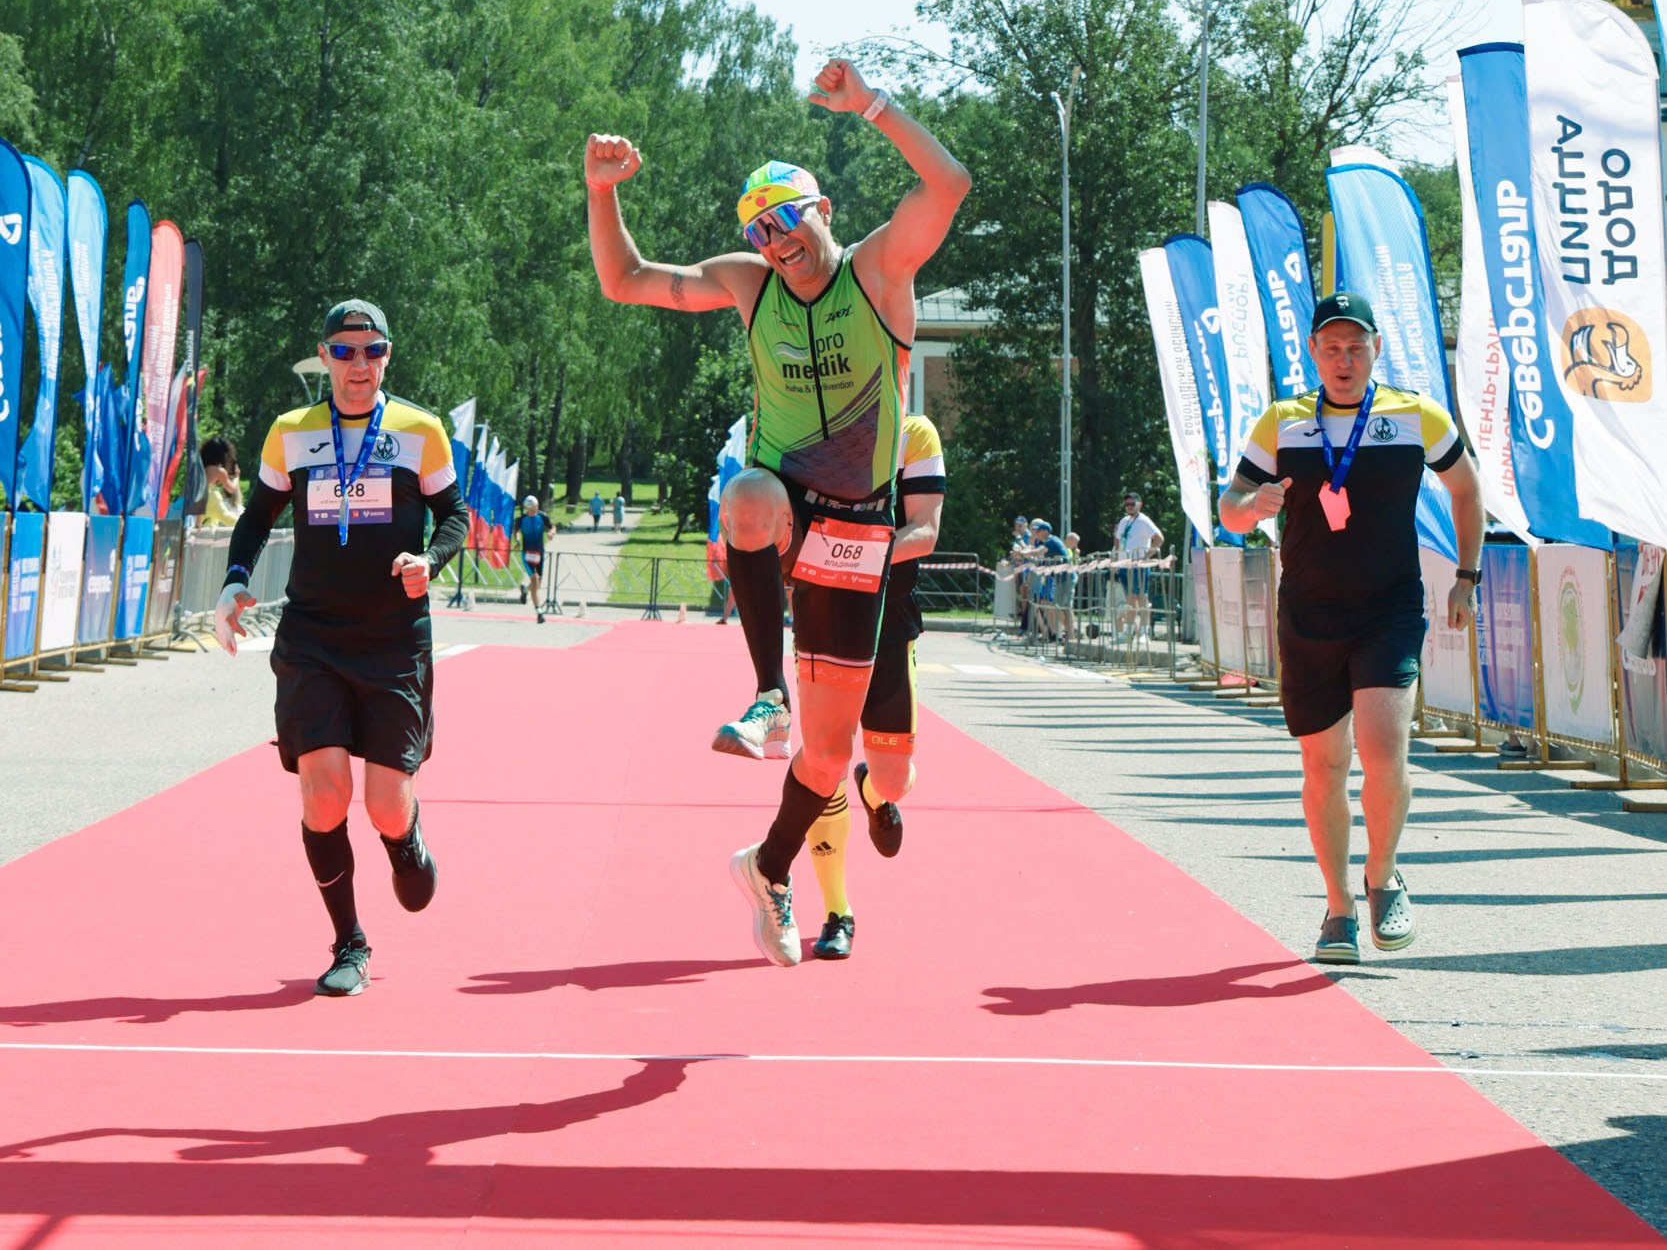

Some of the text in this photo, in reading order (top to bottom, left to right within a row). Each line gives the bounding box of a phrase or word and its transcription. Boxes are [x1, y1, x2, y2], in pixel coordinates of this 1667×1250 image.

[815, 332, 844, 358] pro
[782, 353, 852, 379] medik
[334, 483, 365, 498] 628
[831, 542, 864, 560] 068
